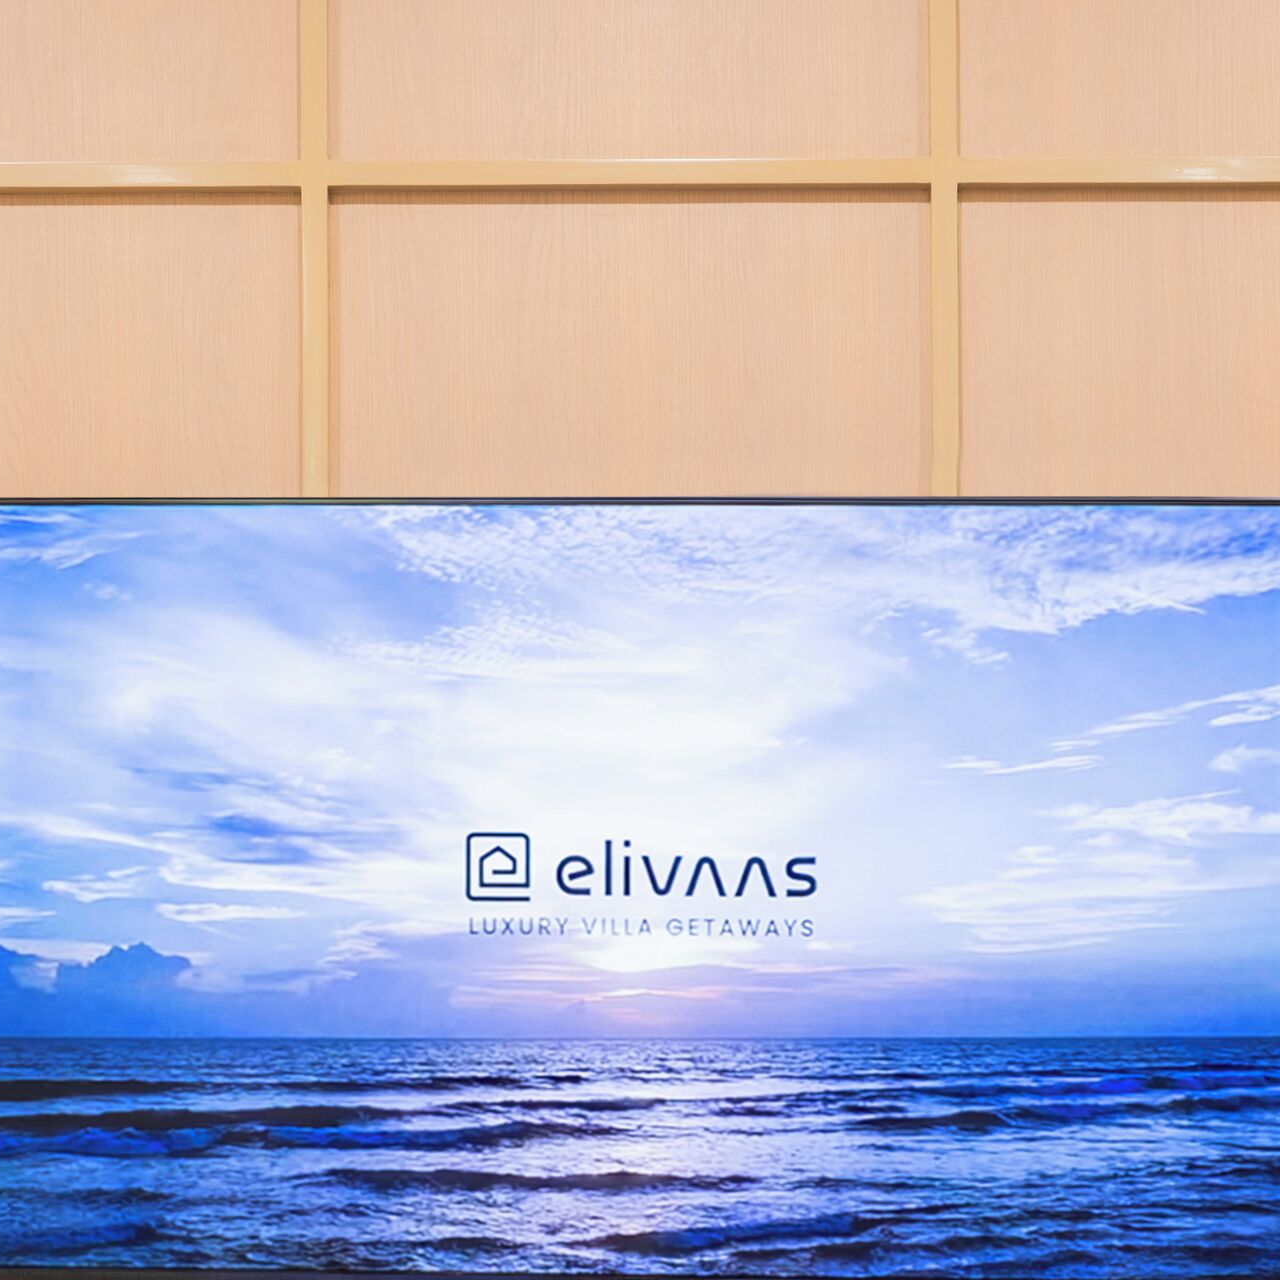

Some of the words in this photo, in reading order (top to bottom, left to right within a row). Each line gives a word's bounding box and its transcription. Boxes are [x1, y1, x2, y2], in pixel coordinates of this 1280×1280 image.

[468, 917, 569, 936] LUXURY
[581, 918, 652, 936] VILLA
[666, 917, 815, 937] GETAWAYS
